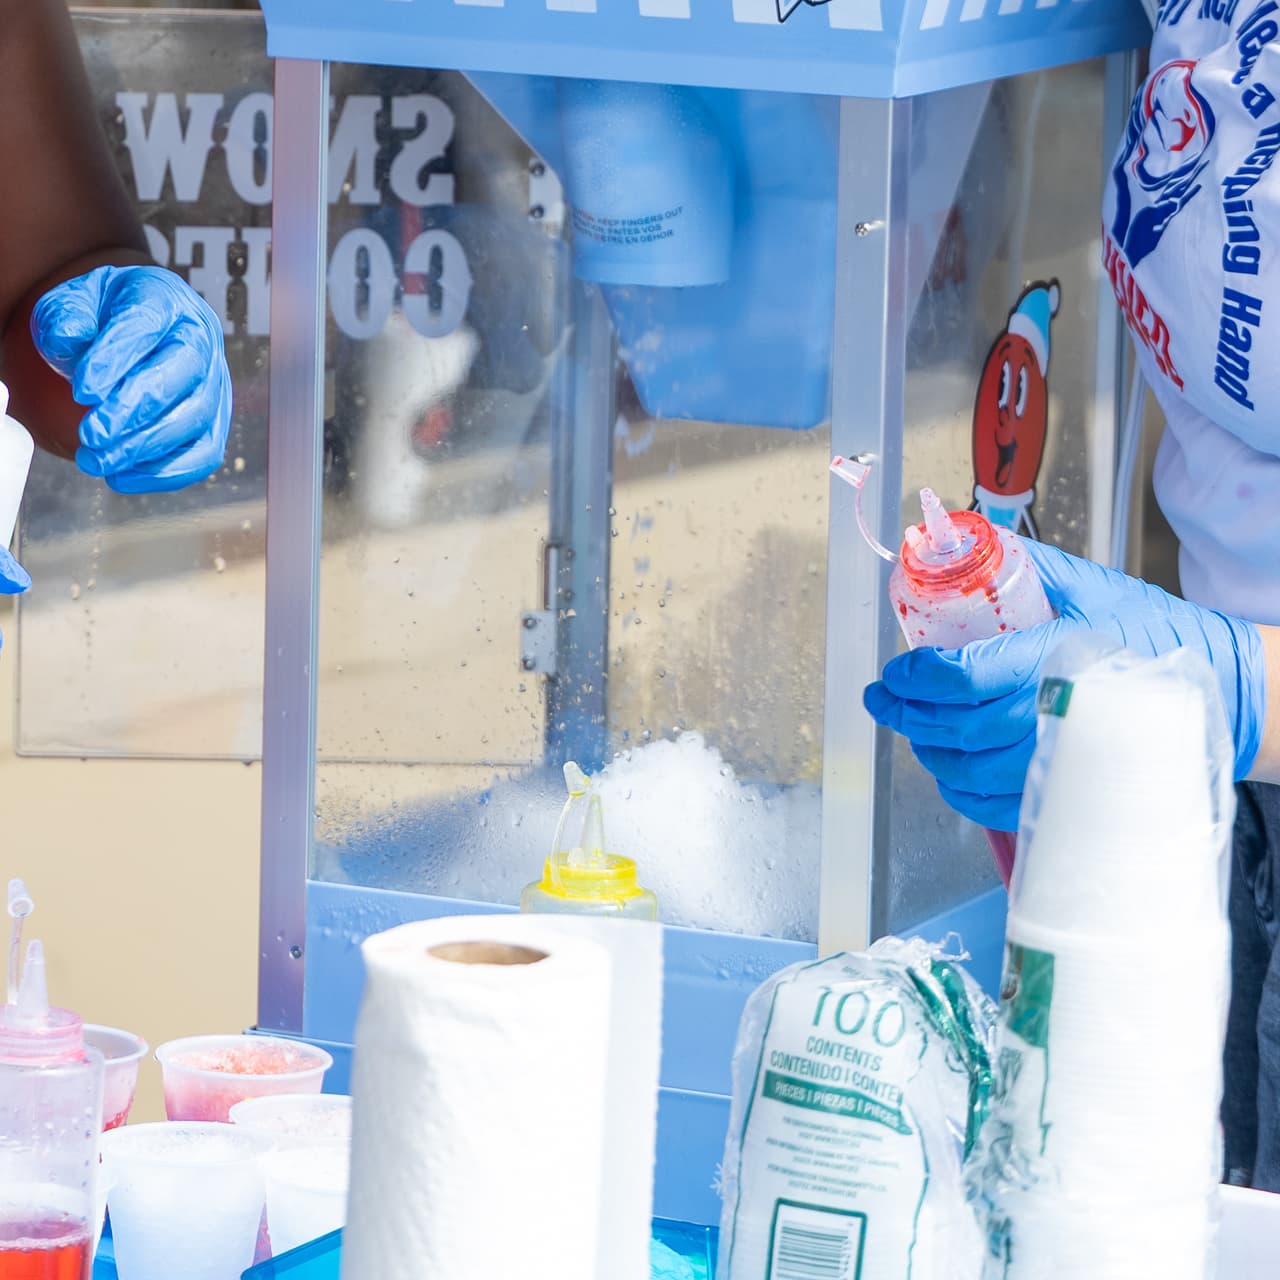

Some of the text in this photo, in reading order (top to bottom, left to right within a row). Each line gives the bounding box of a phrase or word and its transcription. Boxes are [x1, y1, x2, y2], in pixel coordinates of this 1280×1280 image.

[1241, 82, 1276, 120] a
[664, 205, 684, 219] OUT
[1214, 286, 1263, 411] Hand
[812, 985, 907, 1048] 100
[770, 1049, 842, 1082] CONTENIDO
[806, 1035, 883, 1072] CONTENTS
[774, 1081, 806, 1101] PIECES
[813, 1091, 856, 1111] PIEZAS
